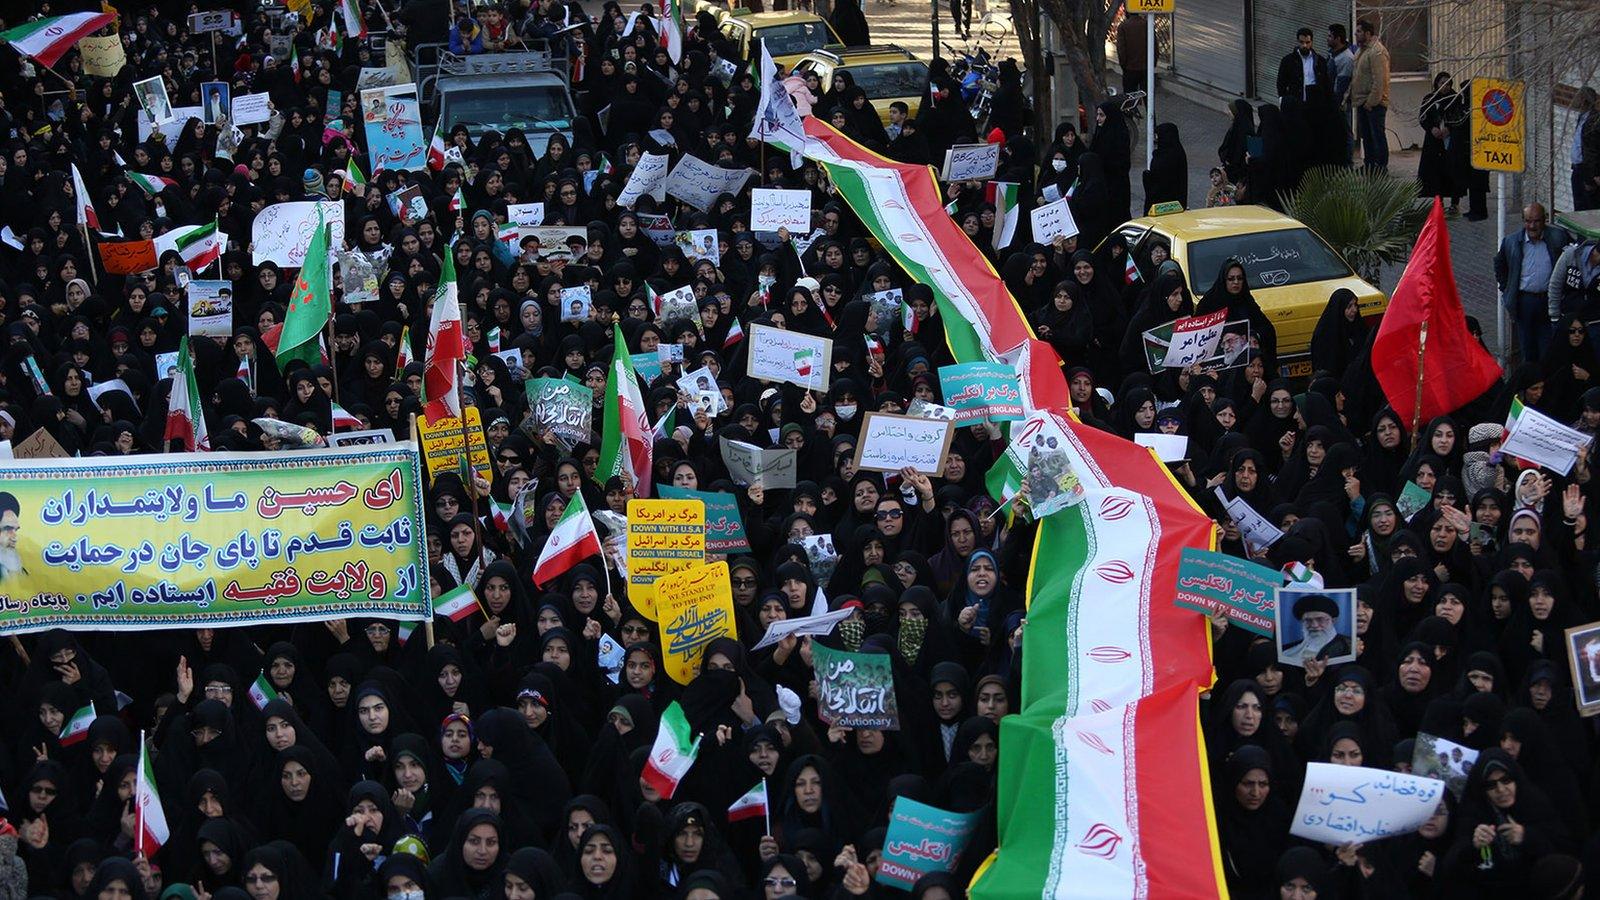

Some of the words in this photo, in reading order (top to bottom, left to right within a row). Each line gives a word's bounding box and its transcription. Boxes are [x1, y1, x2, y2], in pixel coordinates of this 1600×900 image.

[1484, 151, 1512, 165] TAXI
[542, 381, 570, 401] من
[946, 383, 984, 406] انگلیس
[985, 386, 996, 400] بر
[996, 384, 1018, 401] مرگ
[954, 410, 971, 419] OWN
[972, 408, 988, 416] WITH
[989, 405, 1022, 414] ENGLAND
[429, 438, 454, 450] اسرائیل
[204, 484, 247, 511] ما
[257, 481, 358, 518] حسین
[363, 468, 403, 510] ای
[42, 485, 201, 524] ولایتمداران
[636, 508, 665, 522] امریکا
[679, 508, 698, 522] مرگ
[668, 513, 677, 522] بر
[711, 515, 741, 536] مرگ
[261, 529, 281, 559] تا
[285, 521, 354, 564] قدم
[358, 517, 412, 553] ثابت
[634, 535, 667, 548] اسرائیل
[669, 540, 678, 548] بر
[681, 535, 700, 548] مرگ
[706, 540, 746, 549] ENGLAND
[44, 537, 124, 571] حمایت
[121, 541, 154, 572] در
[159, 533, 211, 571] جان
[216, 531, 258, 568] پای
[634, 562, 668, 575] انگلیس
[671, 567, 680, 575] بر
[223, 567, 301, 605] فقیه
[305, 561, 387, 599] ولایت
[394, 564, 416, 598] از
[1180, 574, 1232, 594] انگلیس
[91, 580, 125, 609] ایم
[130, 578, 216, 607] ایستاده
[668, 593, 680, 601] WE
[680, 587, 704, 598] STAND
[705, 583, 716, 591] UP
[684, 598, 698, 607] THE
[699, 593, 715, 602] END
[1229, 588, 1246, 602] بر
[1245, 590, 1275, 611] مرگ
[32, 594, 70, 612] پایگاه
[1177, 592, 1206, 605] DOWN
[1230, 608, 1272, 629] ENGLAND
[827, 654, 855, 680] من
[1418, 782, 1438, 803] قوه
[1303, 812, 1357, 833] اقتصادی
[887, 838, 952, 862] انگلیس
[882, 863, 914, 881] DOWN
